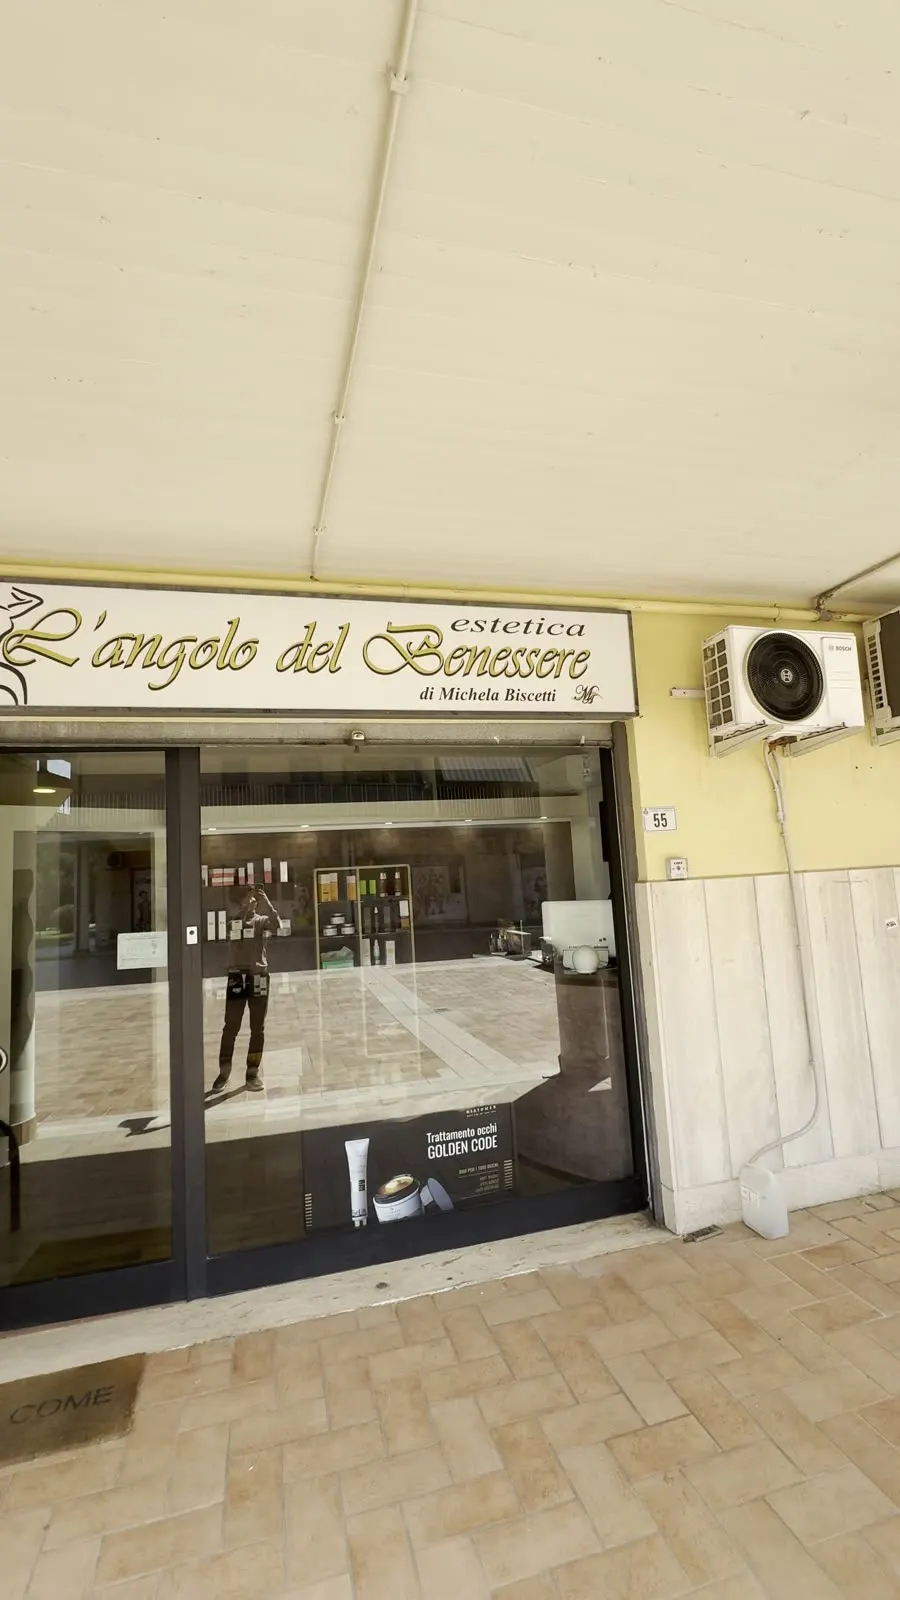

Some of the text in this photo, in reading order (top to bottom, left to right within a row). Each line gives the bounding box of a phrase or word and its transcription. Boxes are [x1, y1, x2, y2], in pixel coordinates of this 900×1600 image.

[450, 617, 586, 637] estetica
[2, 607, 592, 691] L'angolo del Benessere
[419, 686, 557, 703] di Michela Biscetti
[653, 813, 668, 828] 55
[426, 1122, 498, 1144] Trattamento occhi
[427, 1135, 498, 1159] GOLDEN CODE
[9, 1385, 116, 1424] COME
